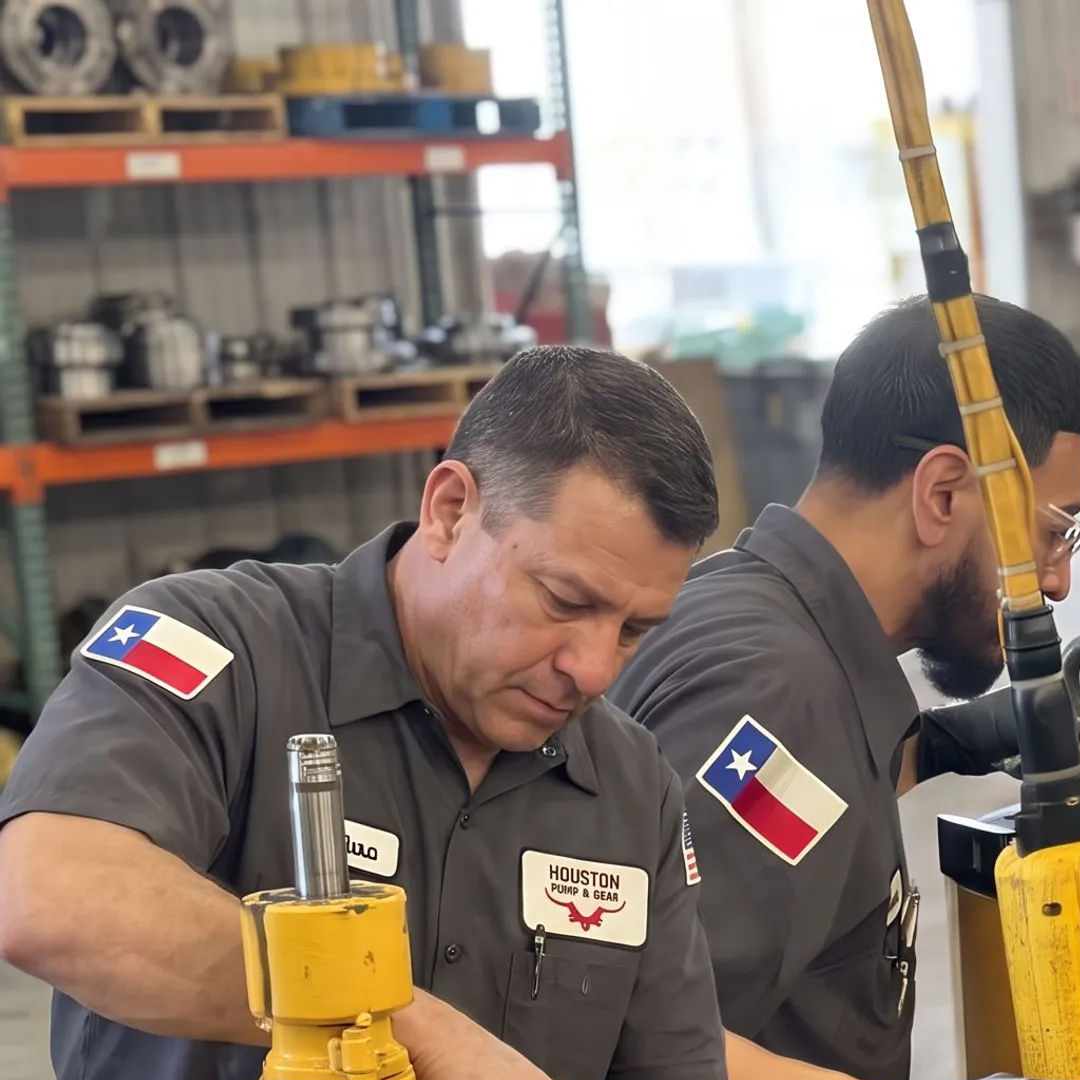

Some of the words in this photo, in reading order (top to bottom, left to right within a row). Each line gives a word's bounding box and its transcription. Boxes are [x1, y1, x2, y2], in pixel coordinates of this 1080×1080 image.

[549, 864, 620, 890] HOUSTON
[551, 883, 579, 897] PUMP
[582, 888, 590, 899] &
[593, 890, 619, 903] GEAR
